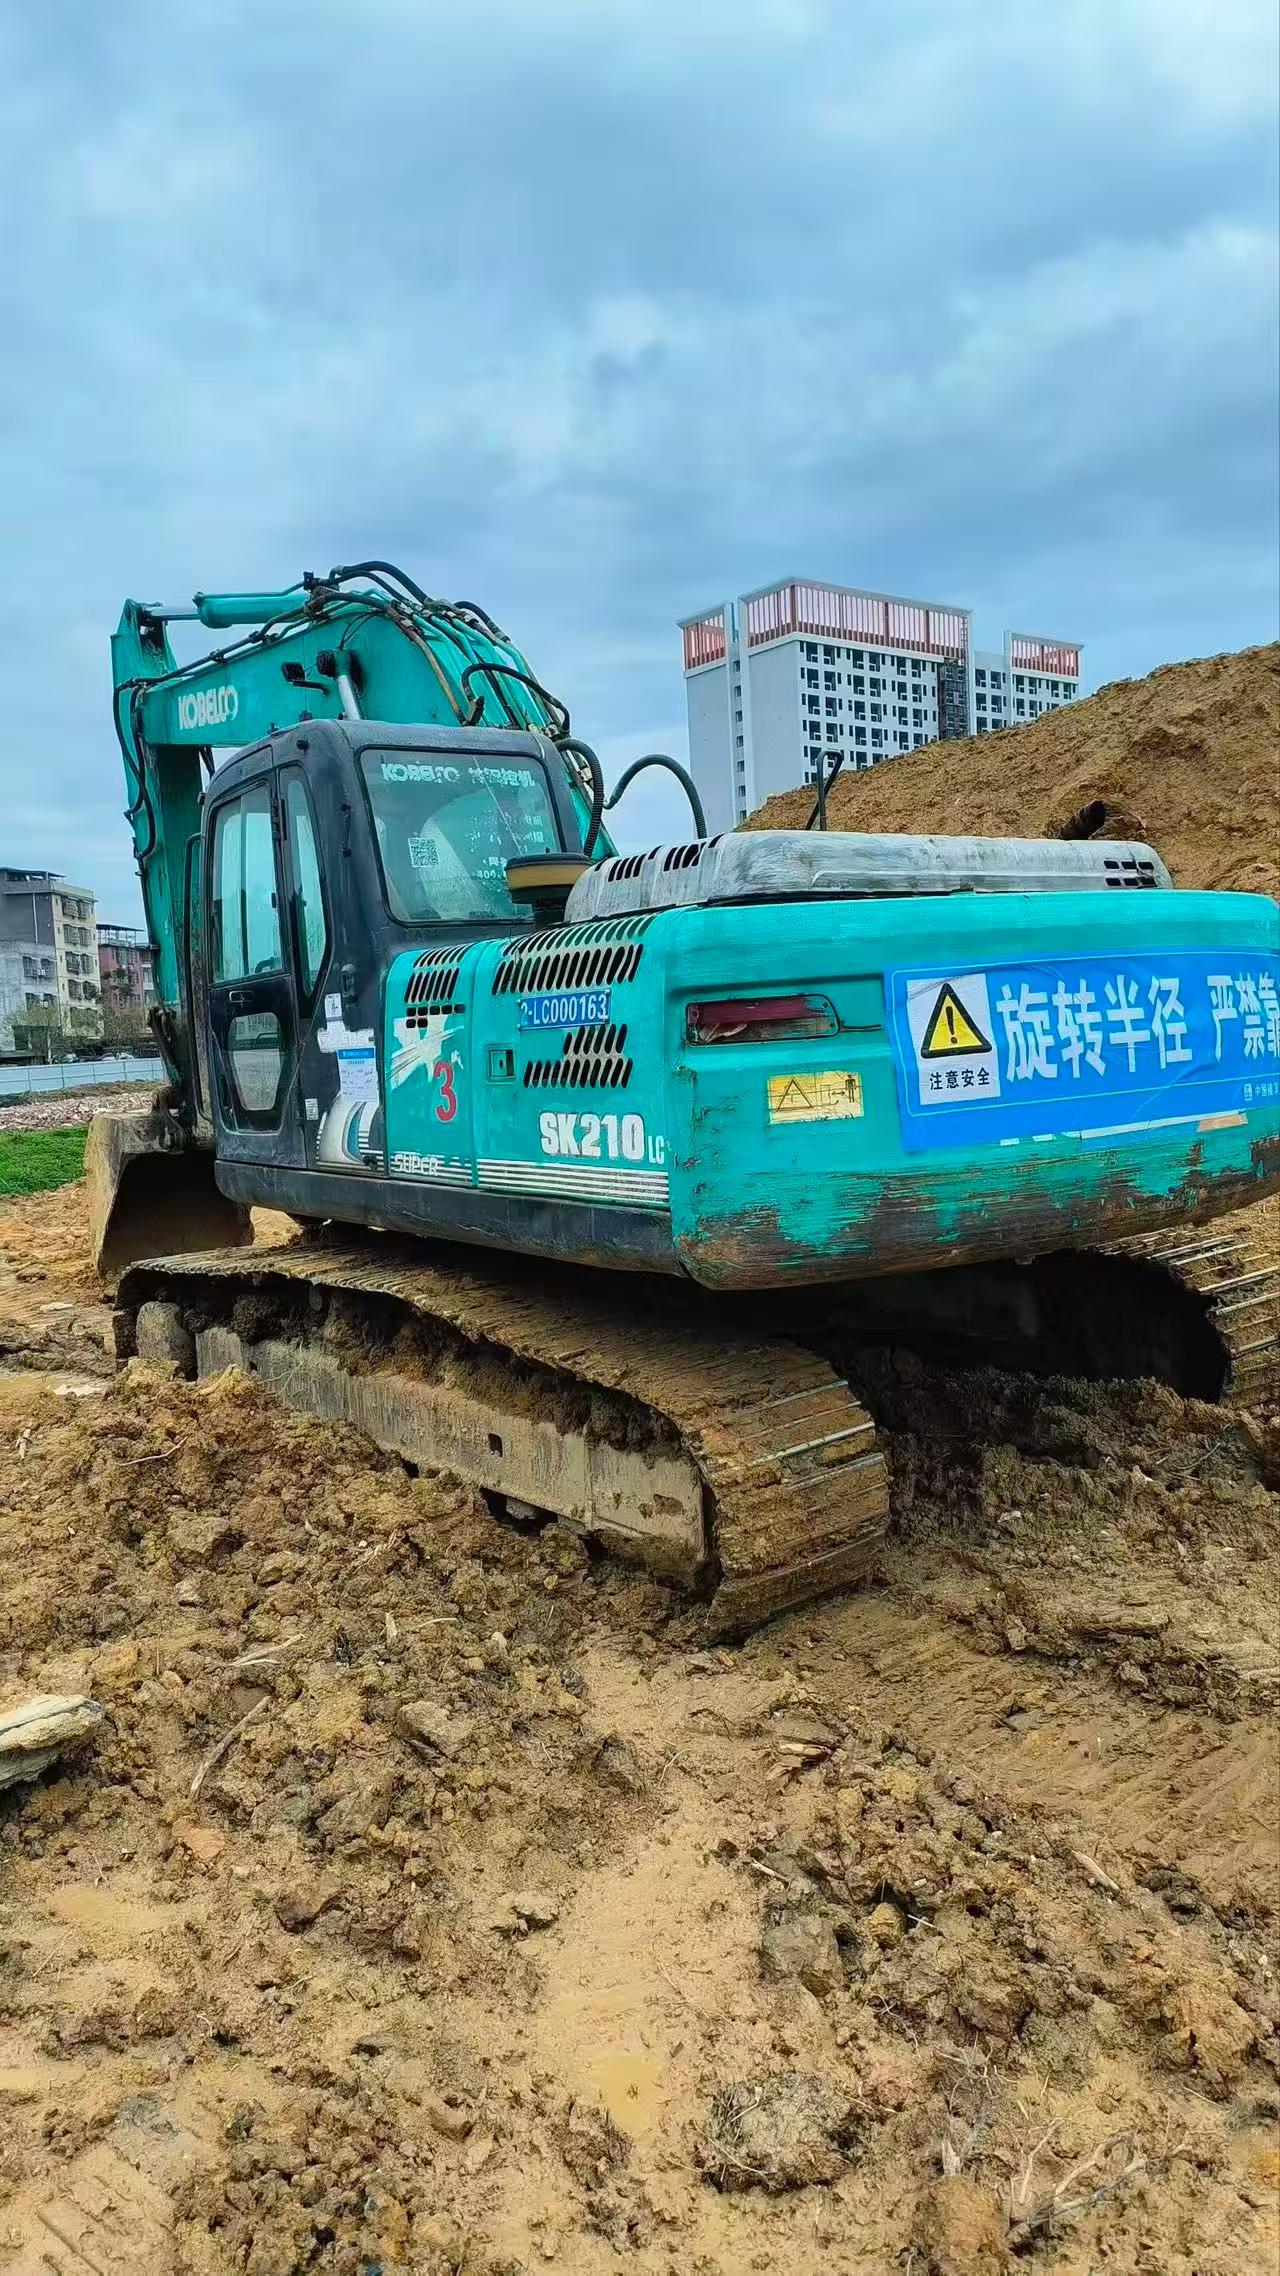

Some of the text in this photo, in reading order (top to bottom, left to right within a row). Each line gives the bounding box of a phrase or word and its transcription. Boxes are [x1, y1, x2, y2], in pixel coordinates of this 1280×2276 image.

[178, 684, 239, 731] KOBELCO
[996, 971, 1280, 1082] 旋转半径 严禁靠
[433, 1060, 459, 1123] 3
[929, 1067, 990, 1091] 注意安全
[539, 1111, 665, 1165] SK210 LC
[394, 1153, 439, 1177] SUPER
